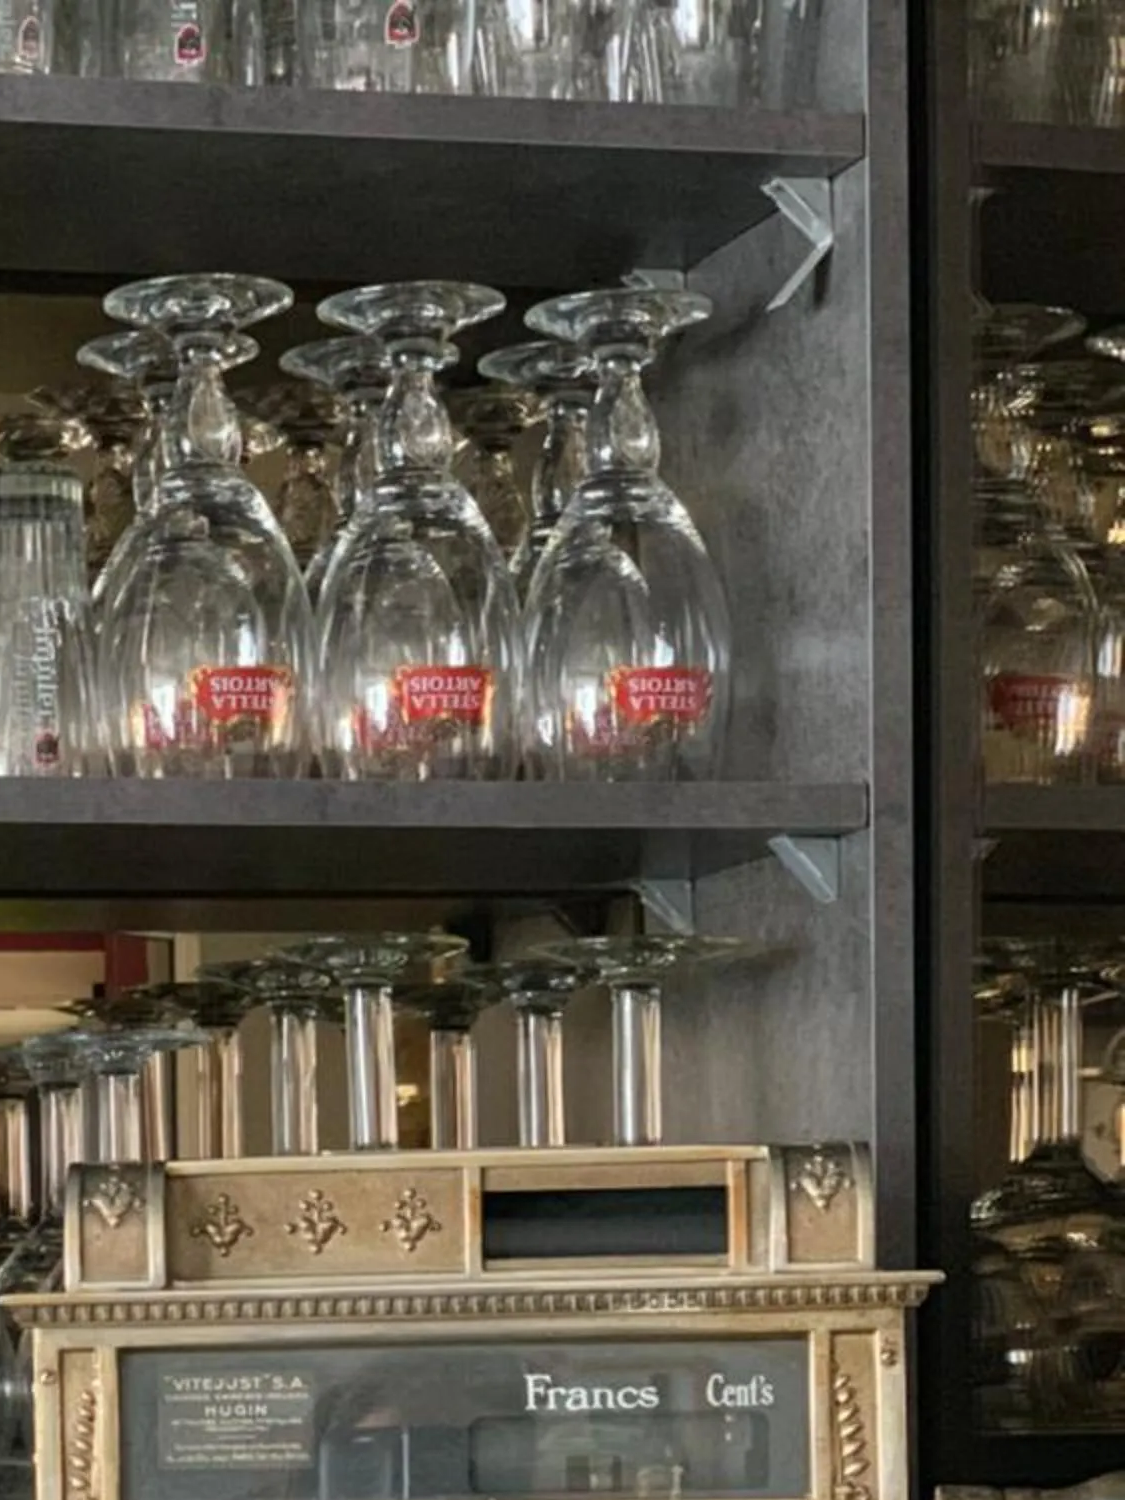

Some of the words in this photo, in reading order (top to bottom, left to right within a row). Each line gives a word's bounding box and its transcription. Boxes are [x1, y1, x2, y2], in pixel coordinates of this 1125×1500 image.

[410, 675, 483, 694] ARTOIS
[627, 675, 697, 694] ARTOIS
[410, 695, 480, 712] STELLA
[523, 1373, 661, 1411] Francs
[706, 1372, 774, 1407] Cent's
